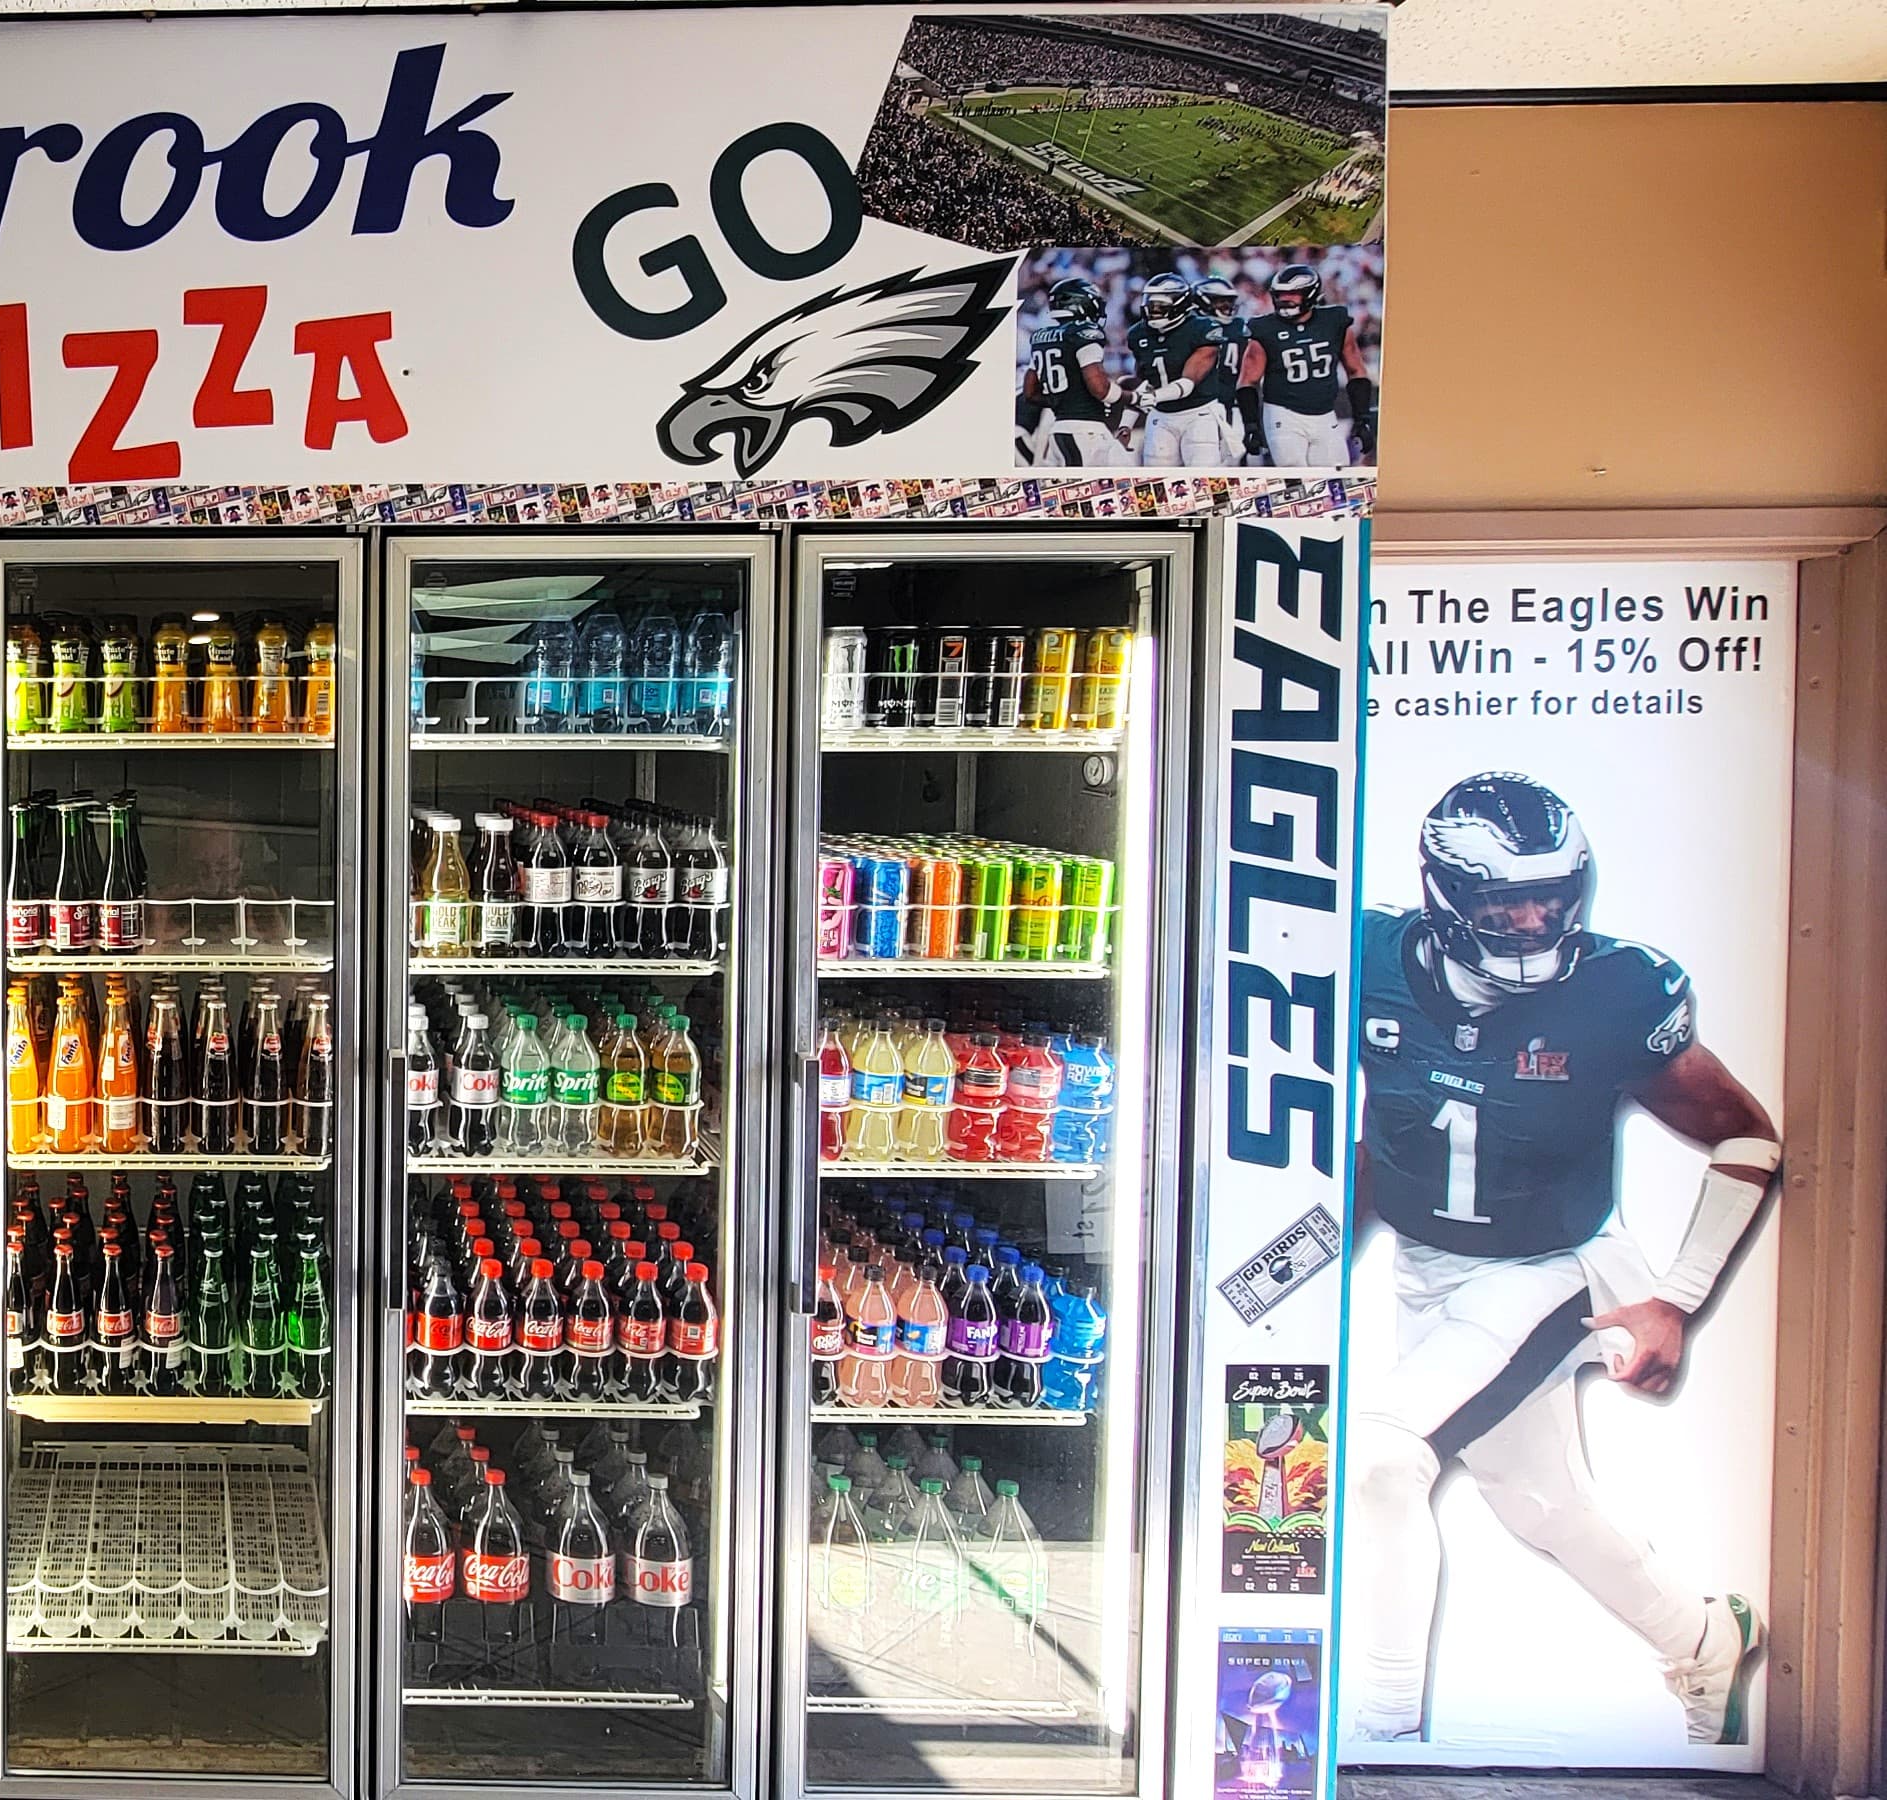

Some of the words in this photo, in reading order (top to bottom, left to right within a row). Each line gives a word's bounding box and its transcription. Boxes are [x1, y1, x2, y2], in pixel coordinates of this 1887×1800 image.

[572, 121, 865, 340] GO
[1281, 341, 1333, 384] 65
[1408, 589, 1490, 625] The
[1512, 587, 1665, 632] Eagles
[1685, 586, 1769, 622] Win
[1429, 640, 1513, 674] Win
[1567, 637, 1658, 674] 15%
[1678, 636, 1763, 672] Off!
[1395, 691, 1518, 717] cashier
[1531, 690, 1578, 716] for
[1591, 689, 1704, 715] details
[1227, 523, 1345, 1178] EAGLES
[434, 905, 457, 916] OLD
[61, 1039, 79, 1065] Fanta
[409, 1073, 438, 1091] oke
[502, 1071, 550, 1091] Sprite
[1430, 1099, 1492, 1225] 1
[1243, 1263, 1264, 1282] GO
[1262, 1226, 1307, 1265] BIRDS
